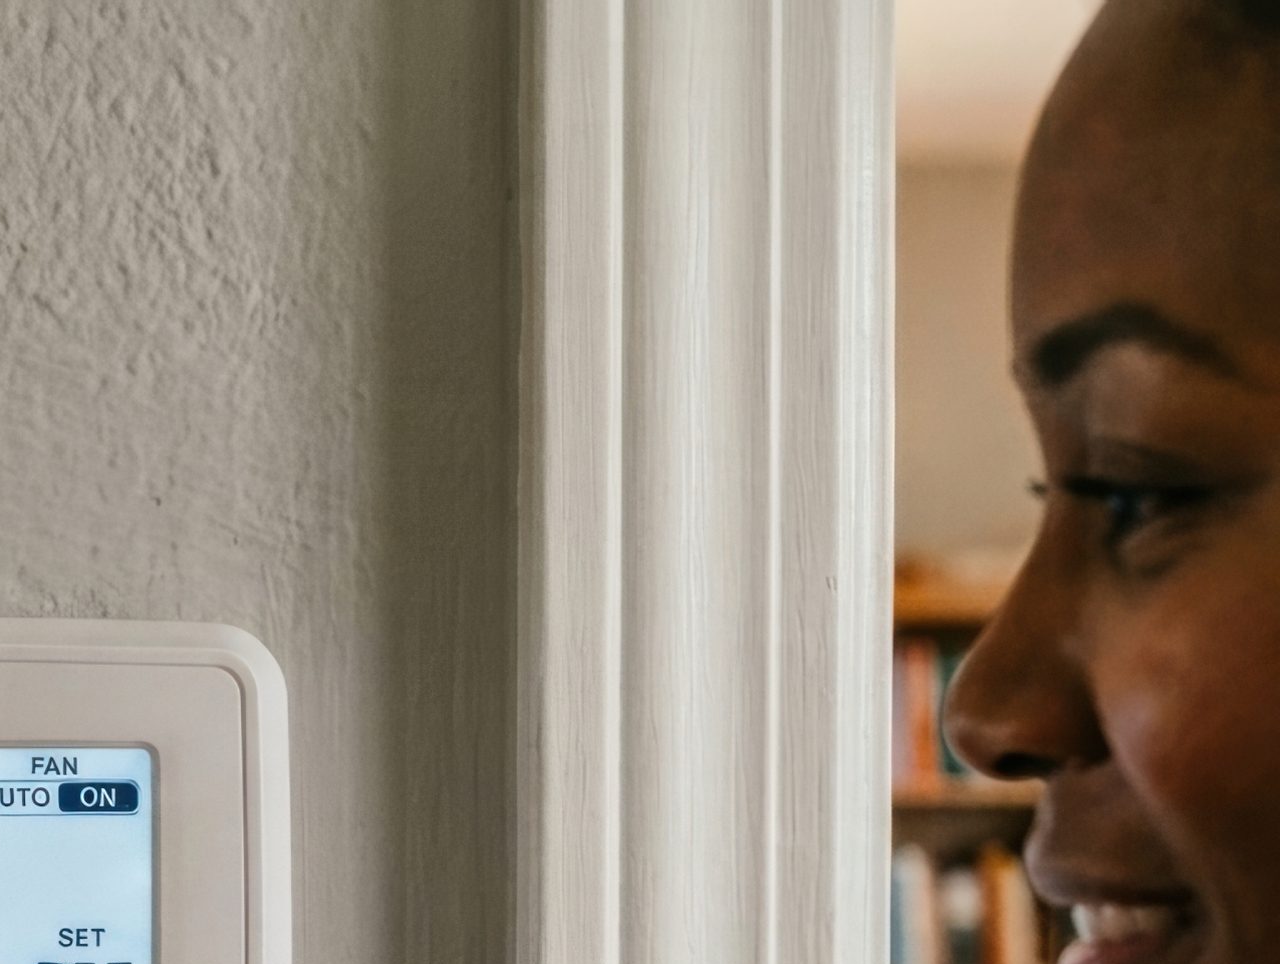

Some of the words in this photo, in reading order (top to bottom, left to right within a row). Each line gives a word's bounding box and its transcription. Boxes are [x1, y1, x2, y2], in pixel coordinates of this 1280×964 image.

[31, 757, 78, 775] FAN
[80, 786, 116, 807] ON
[58, 928, 105, 947] SET
